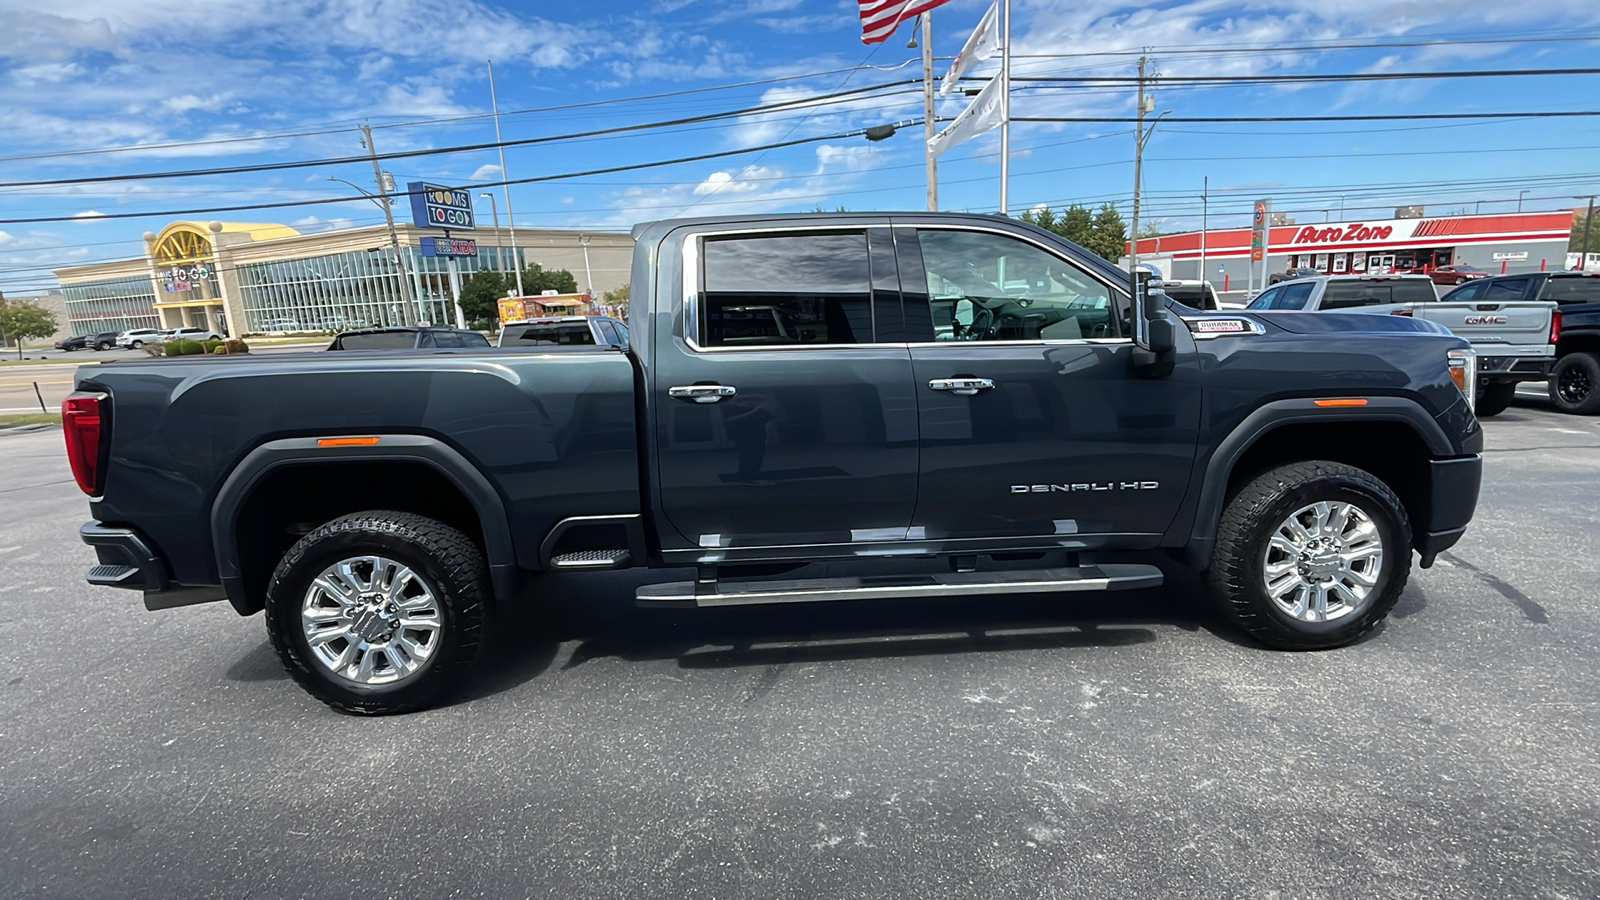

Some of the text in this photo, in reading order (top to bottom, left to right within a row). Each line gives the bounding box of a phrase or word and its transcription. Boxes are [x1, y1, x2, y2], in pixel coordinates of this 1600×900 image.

[428, 188, 467, 207] ROOMS
[431, 207, 464, 224] TO GO
[1295, 223, 1393, 243] AutoZone
[451, 240, 476, 255] KIDS
[191, 268, 208, 279] GO
[1465, 315, 1507, 325] GMC
[1010, 481, 1159, 494] DENALI HD
